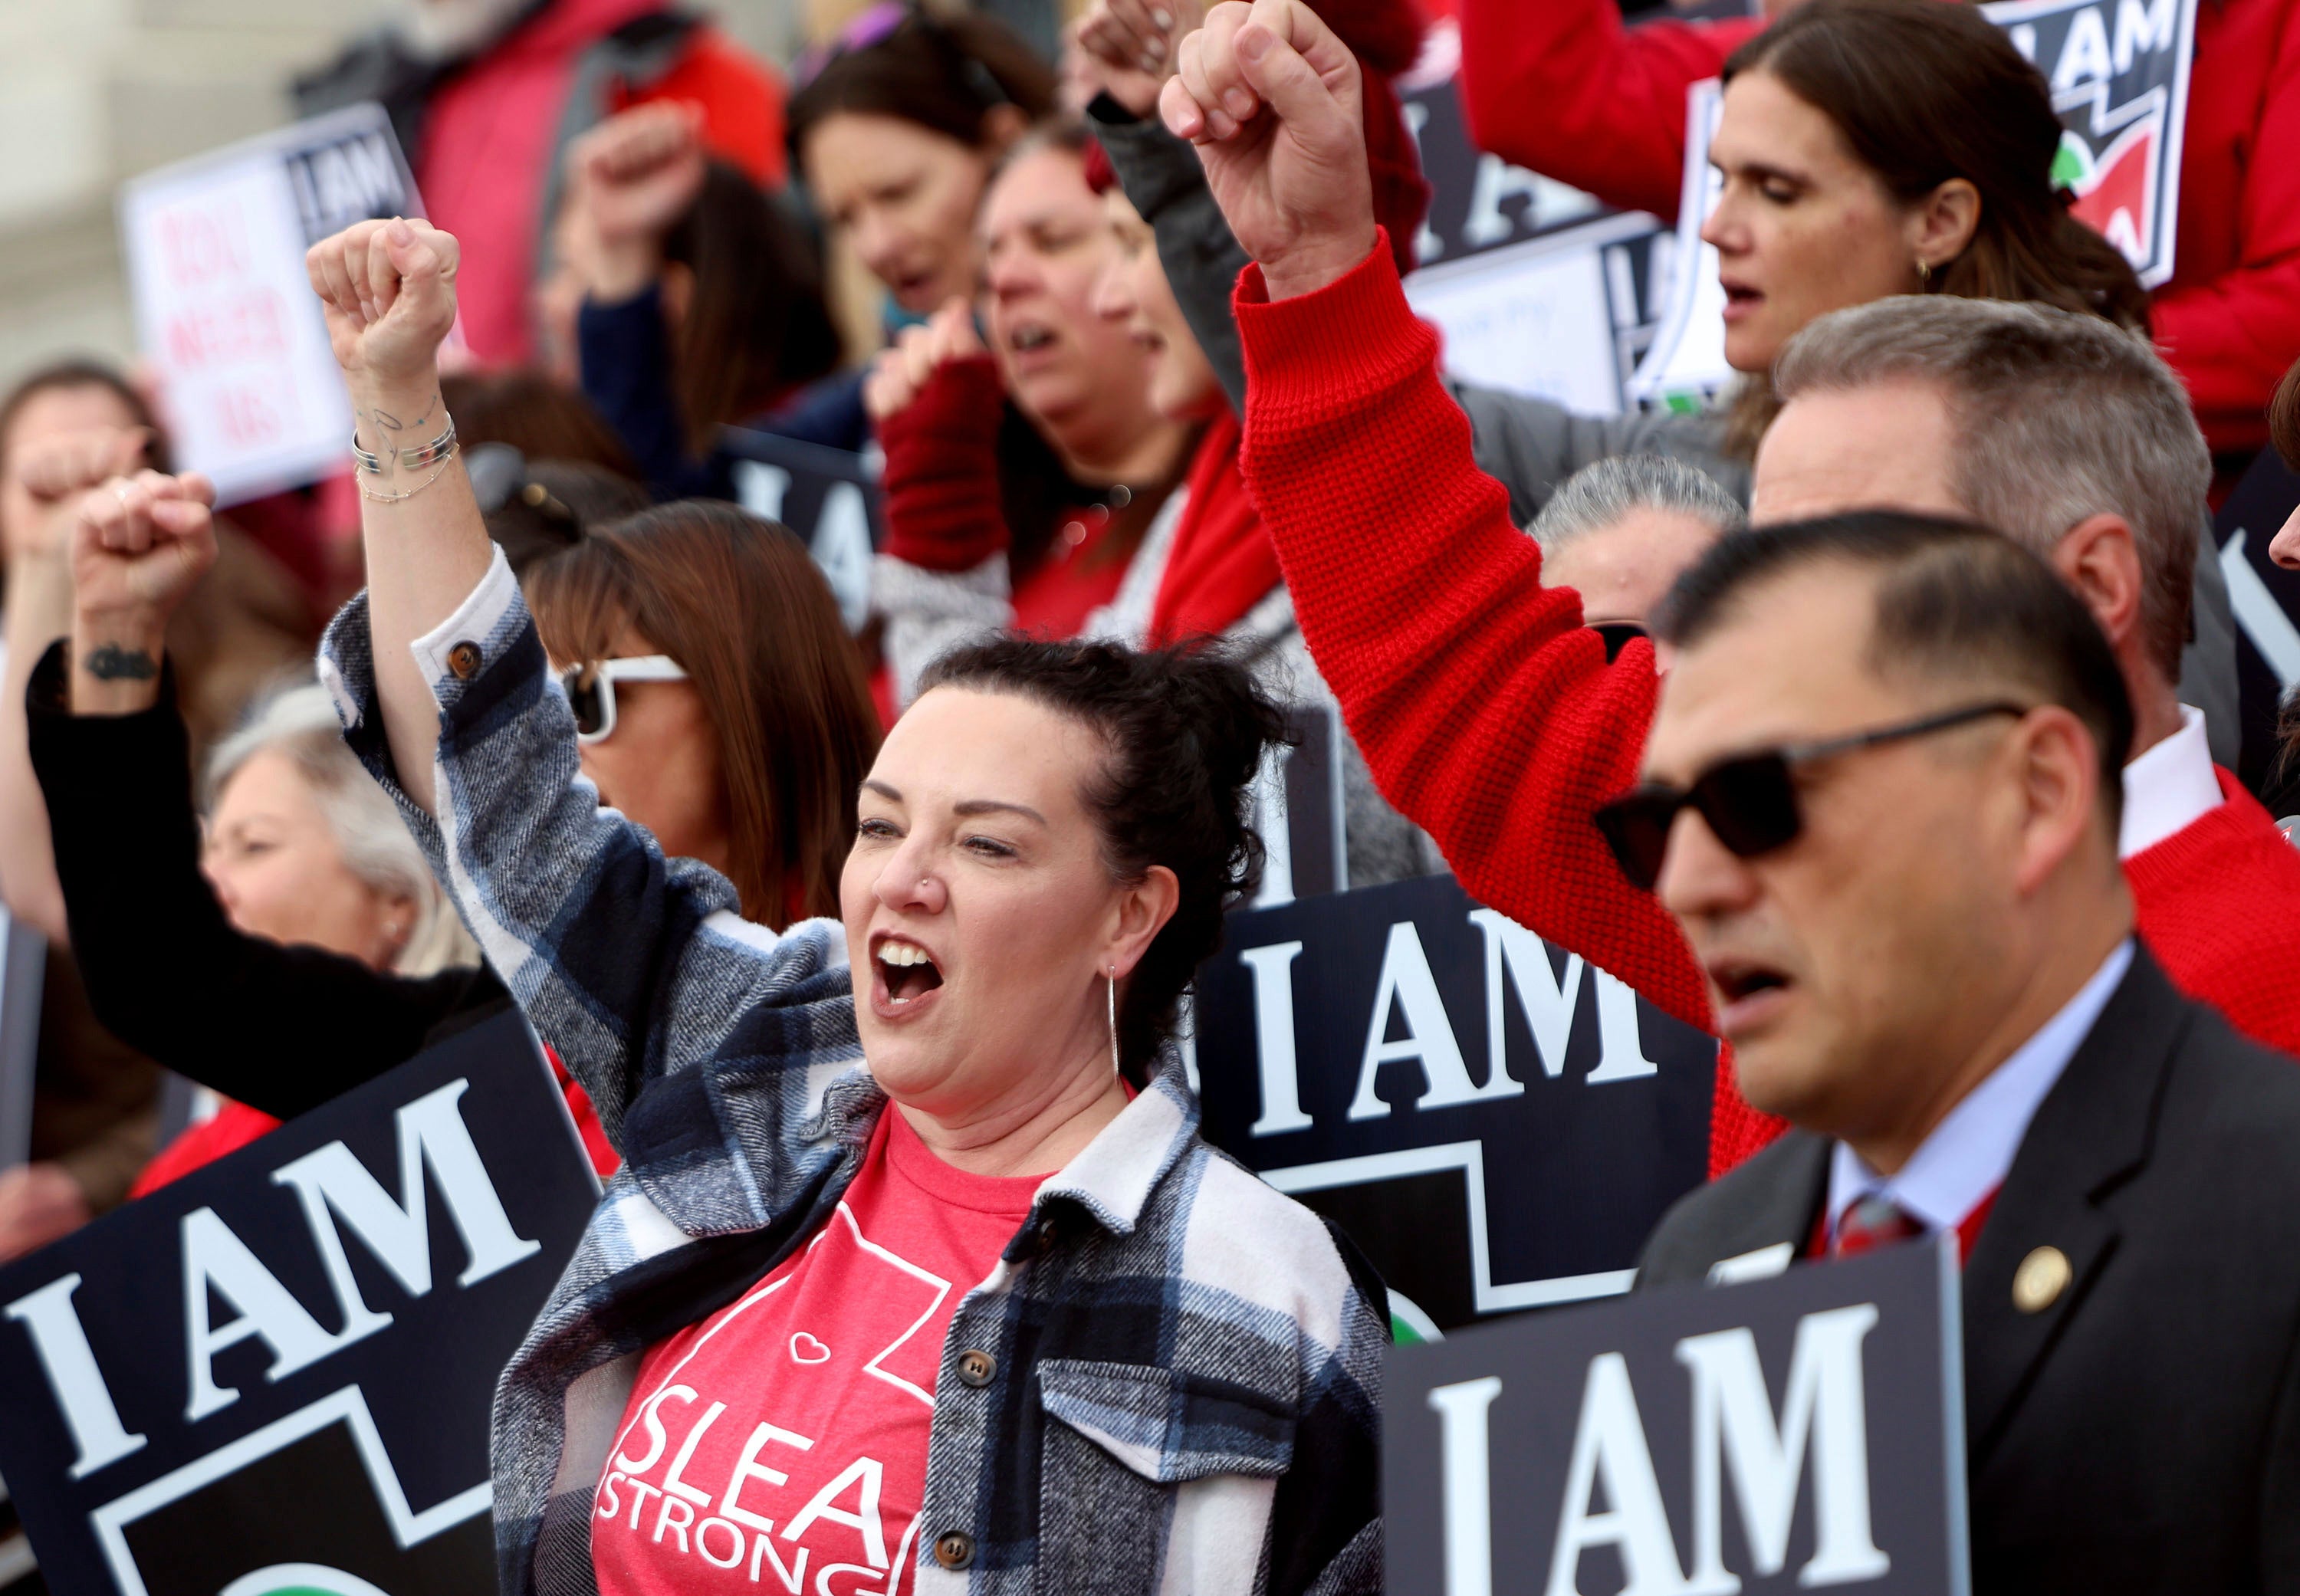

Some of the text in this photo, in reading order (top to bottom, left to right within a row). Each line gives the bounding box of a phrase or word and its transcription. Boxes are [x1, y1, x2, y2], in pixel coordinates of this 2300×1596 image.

[2050, 0, 2174, 94] AM
[1240, 940, 1314, 1136] I
[1346, 907, 1659, 1121] AM
[4, 1077, 542, 1479] I AM
[616, 1384, 890, 1570] SLEA
[1428, 1302, 1891, 1596] I AM
